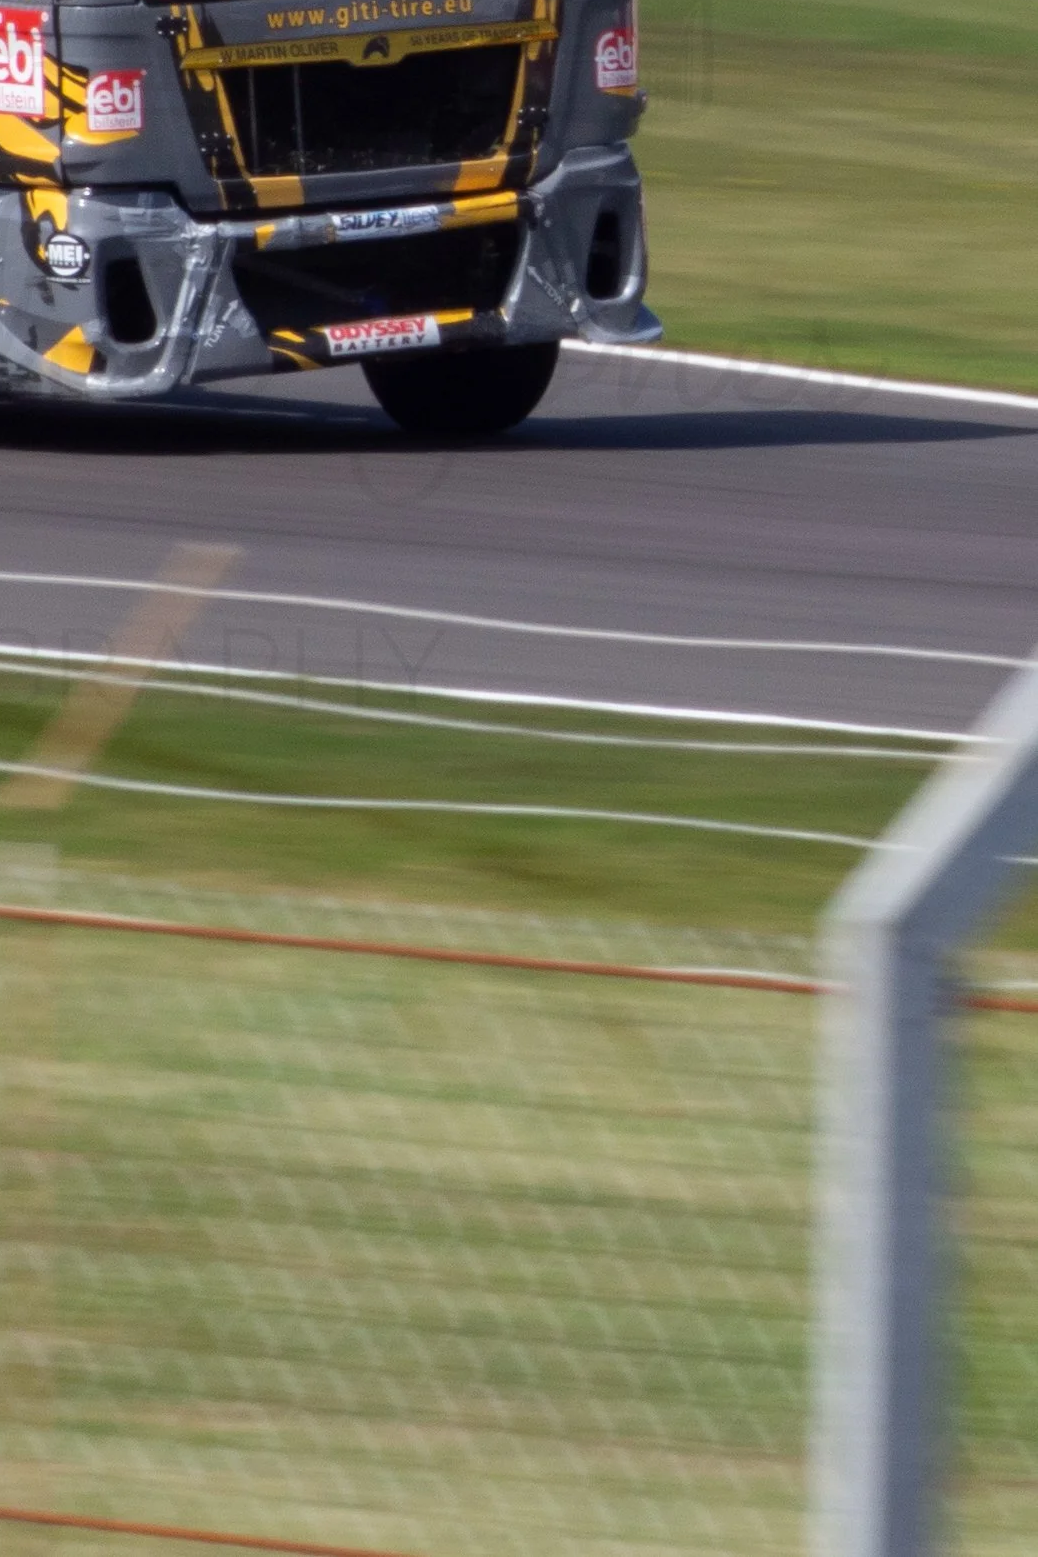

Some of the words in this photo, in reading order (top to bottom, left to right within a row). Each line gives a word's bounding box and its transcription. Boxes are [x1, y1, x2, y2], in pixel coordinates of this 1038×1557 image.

[290, 41, 339, 57] OLIVER
[86, 75, 141, 113] febi
[330, 316, 425, 342] ODYSSEY
[334, 334, 425, 353] BATTERY
